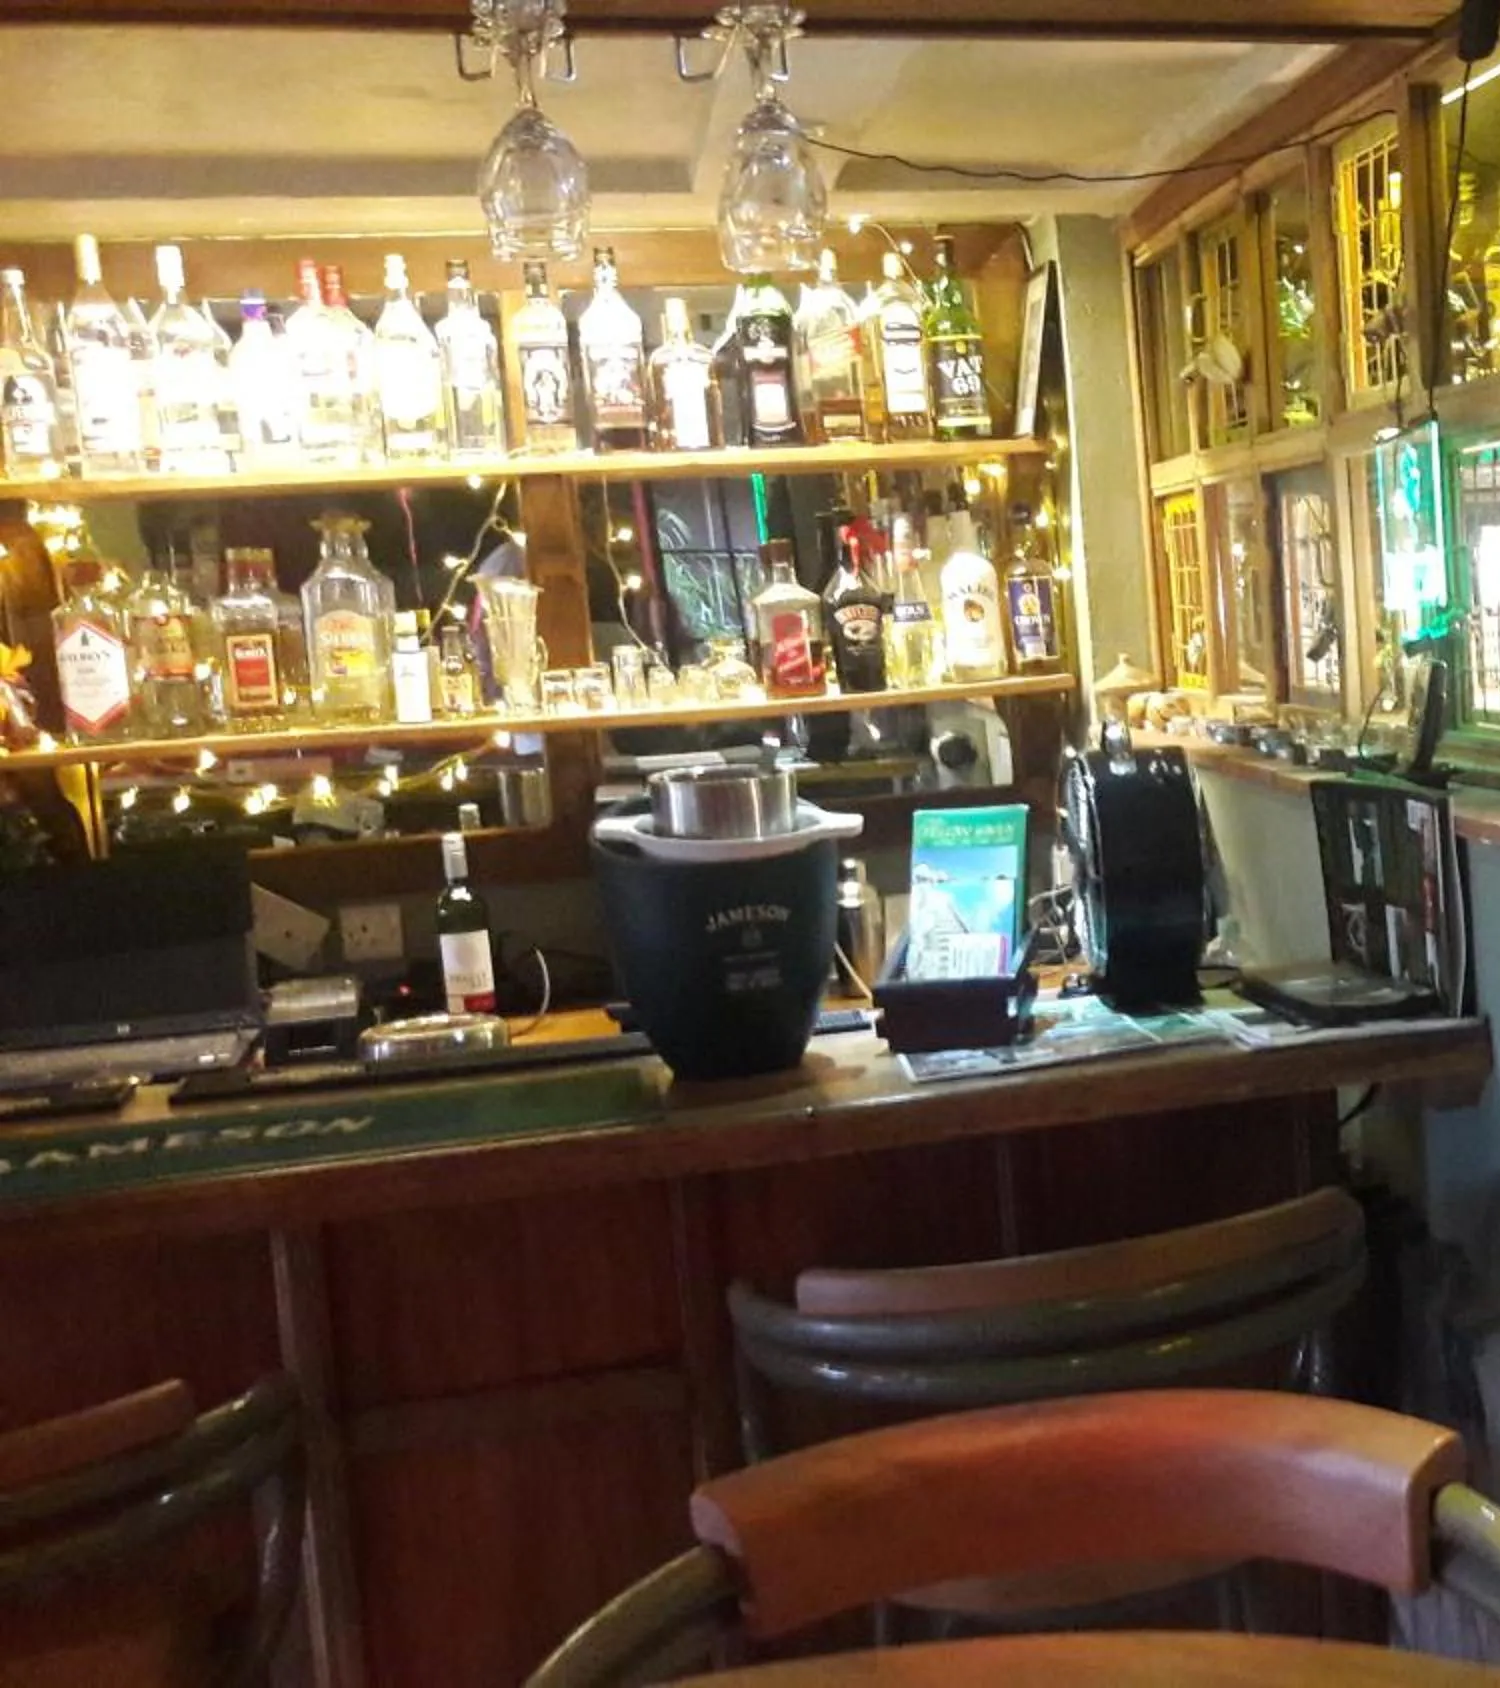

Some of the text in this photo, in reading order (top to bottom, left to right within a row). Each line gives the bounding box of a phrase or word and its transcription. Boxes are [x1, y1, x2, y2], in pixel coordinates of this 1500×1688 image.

[936, 355, 983, 379] VAT
[952, 374, 981, 396] 69
[704, 903, 793, 933] JAMESON
